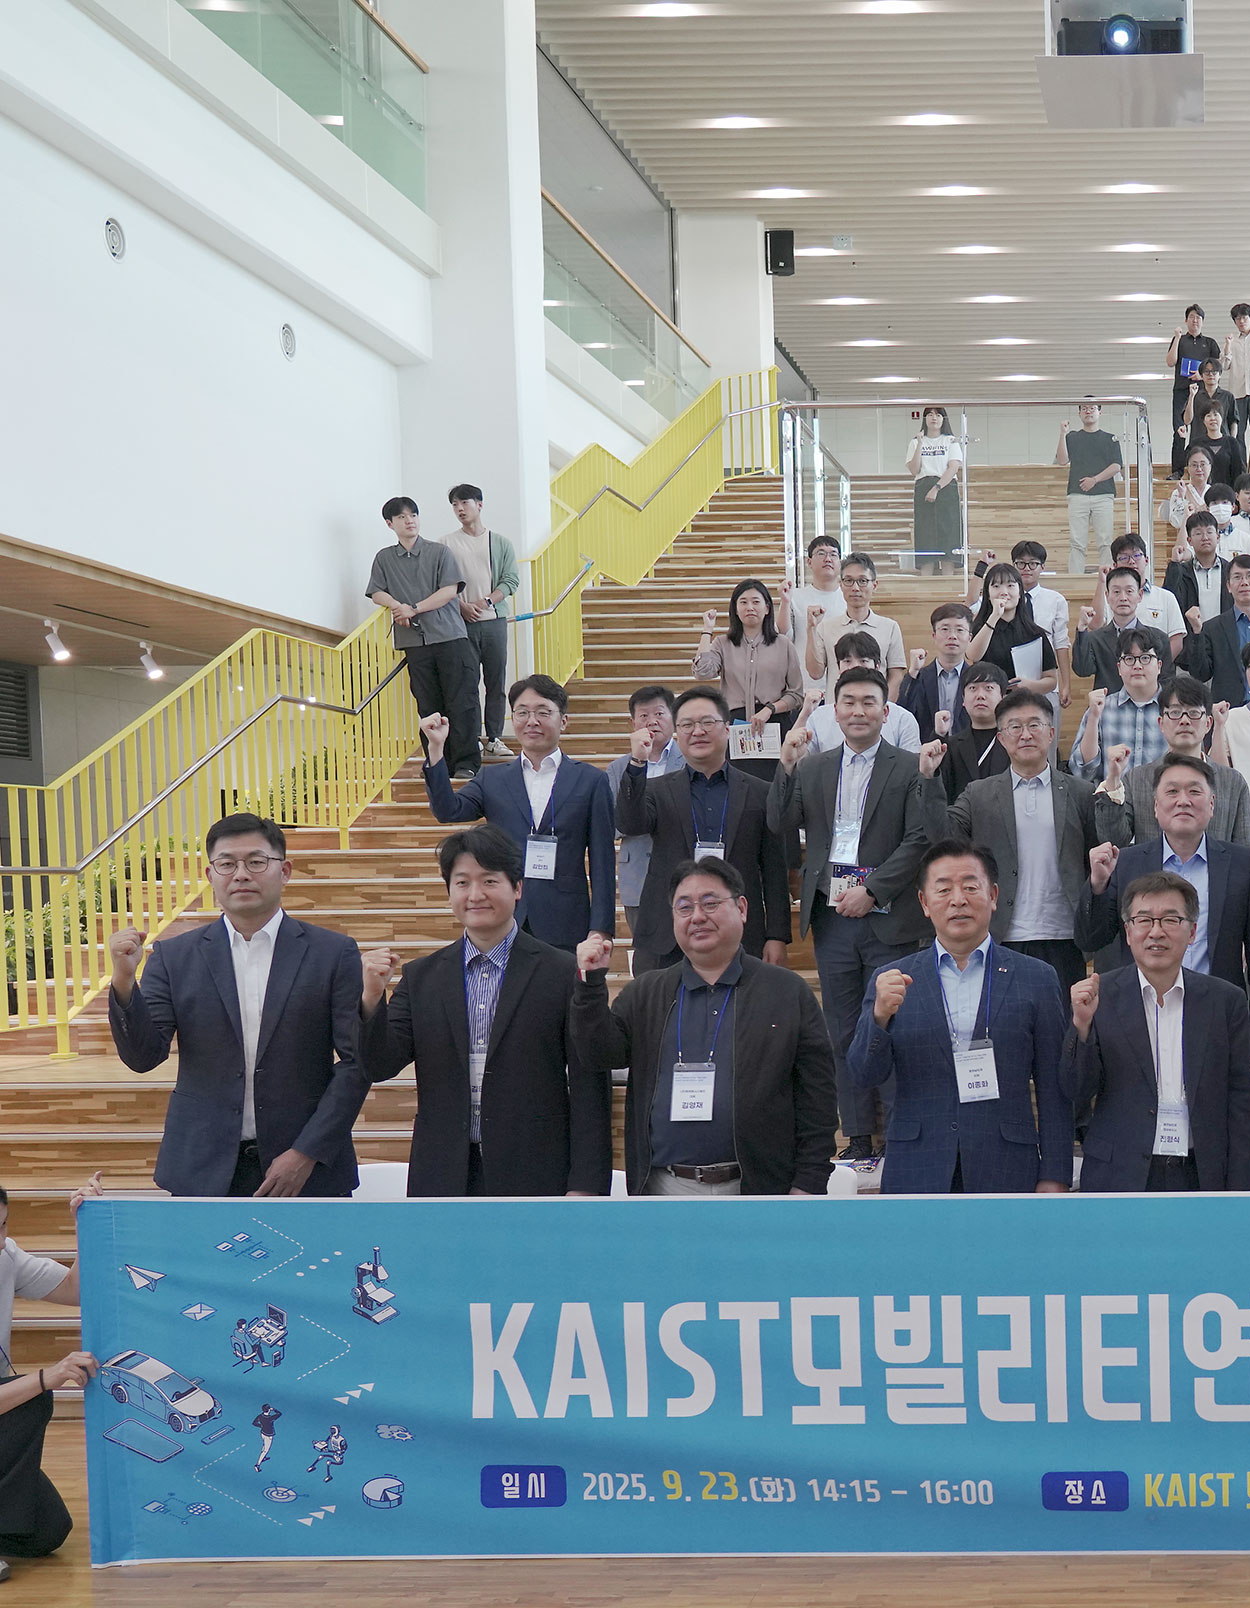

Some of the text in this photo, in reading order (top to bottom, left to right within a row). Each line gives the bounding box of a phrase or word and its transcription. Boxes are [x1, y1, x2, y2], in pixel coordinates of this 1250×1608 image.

[967, 1080, 989, 1089] 이종화
[583, 1472, 655, 1502] 2025.
[807, 1478, 881, 1503] 14:15
[919, 1479, 994, 1505] 16:00
[1144, 1472, 1232, 1507] KAIST
